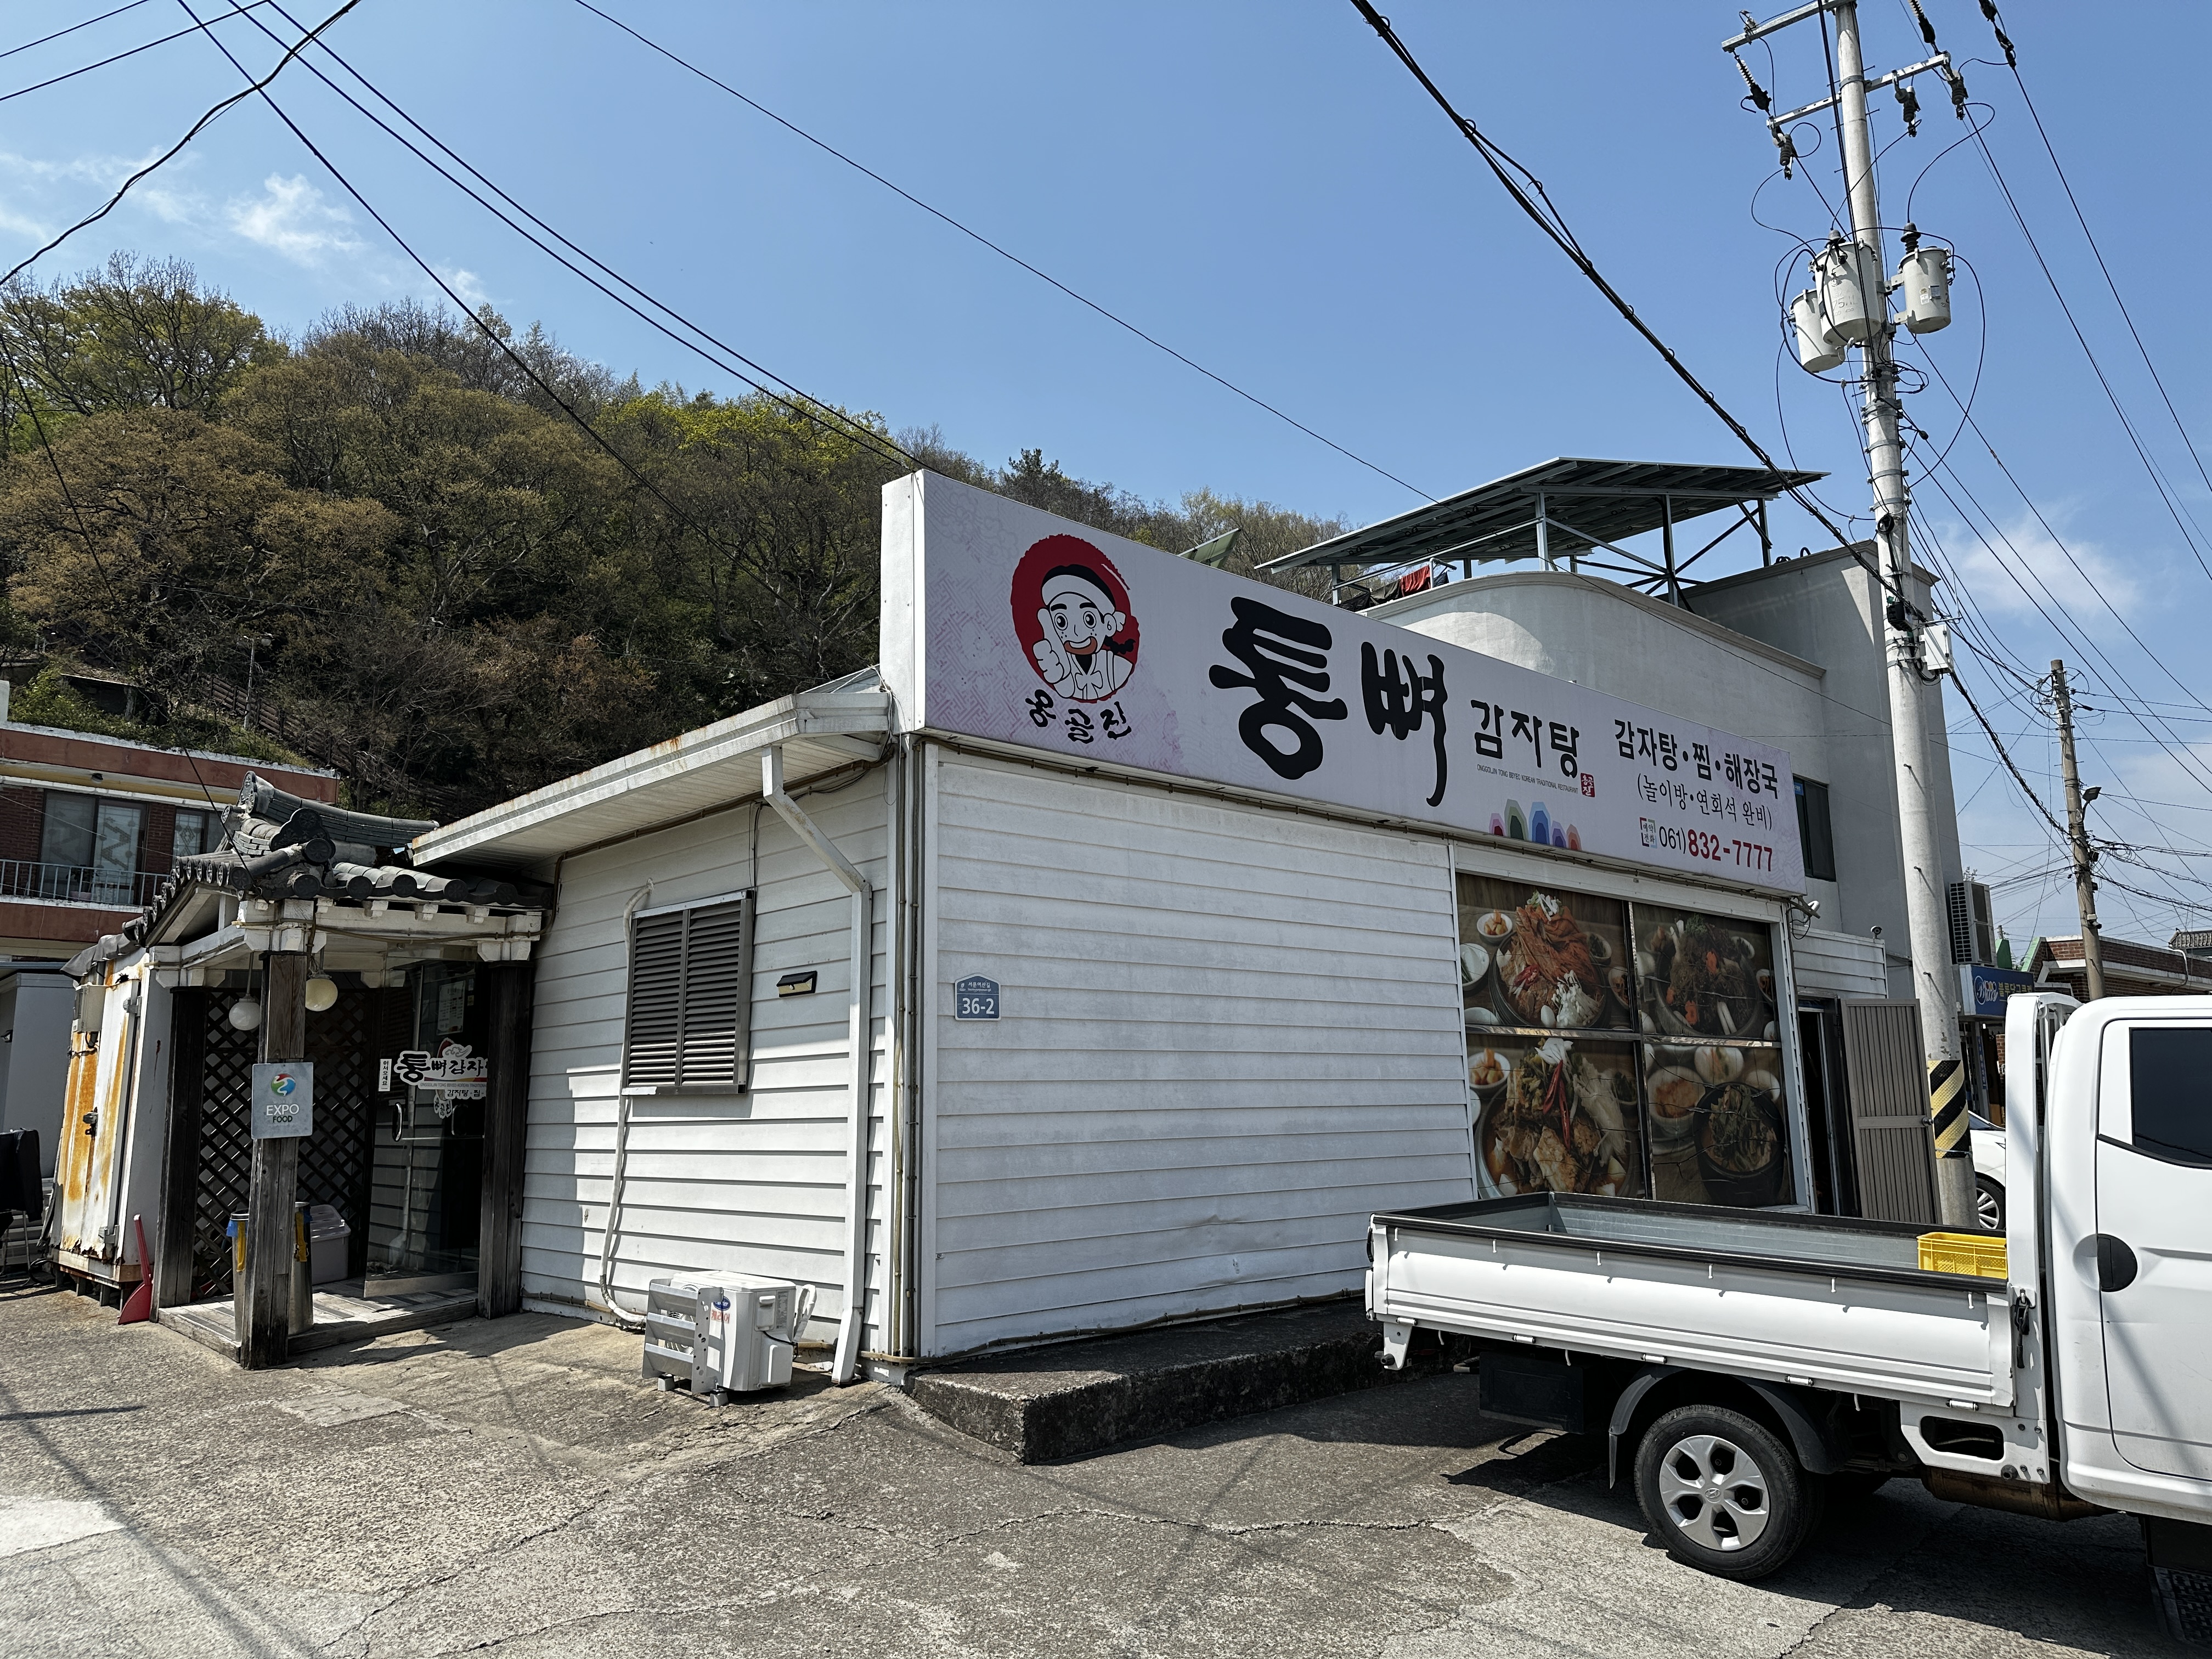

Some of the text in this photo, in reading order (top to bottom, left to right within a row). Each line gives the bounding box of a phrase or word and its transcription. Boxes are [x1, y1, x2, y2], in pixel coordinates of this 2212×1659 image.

[1025, 689, 1132, 744] 옹골진
[1470, 699, 1579, 778] 감자탕
[1498, 769, 1508, 777] TONG
[1521, 774, 1536, 784] KOREAN
[1536, 778, 1557, 789] TRADITIONAL
[1558, 783, 1578, 794] RESTAURANT
[1643, 823, 1654, 833] 예약
[1742, 801, 1772, 831] 완비)
[1643, 834, 1655, 844] 전화
[962, 998, 995, 1014] 36-2
[397, 1053, 488, 1082] 통뼈감자
[266, 1104, 300, 1116] EXPO
